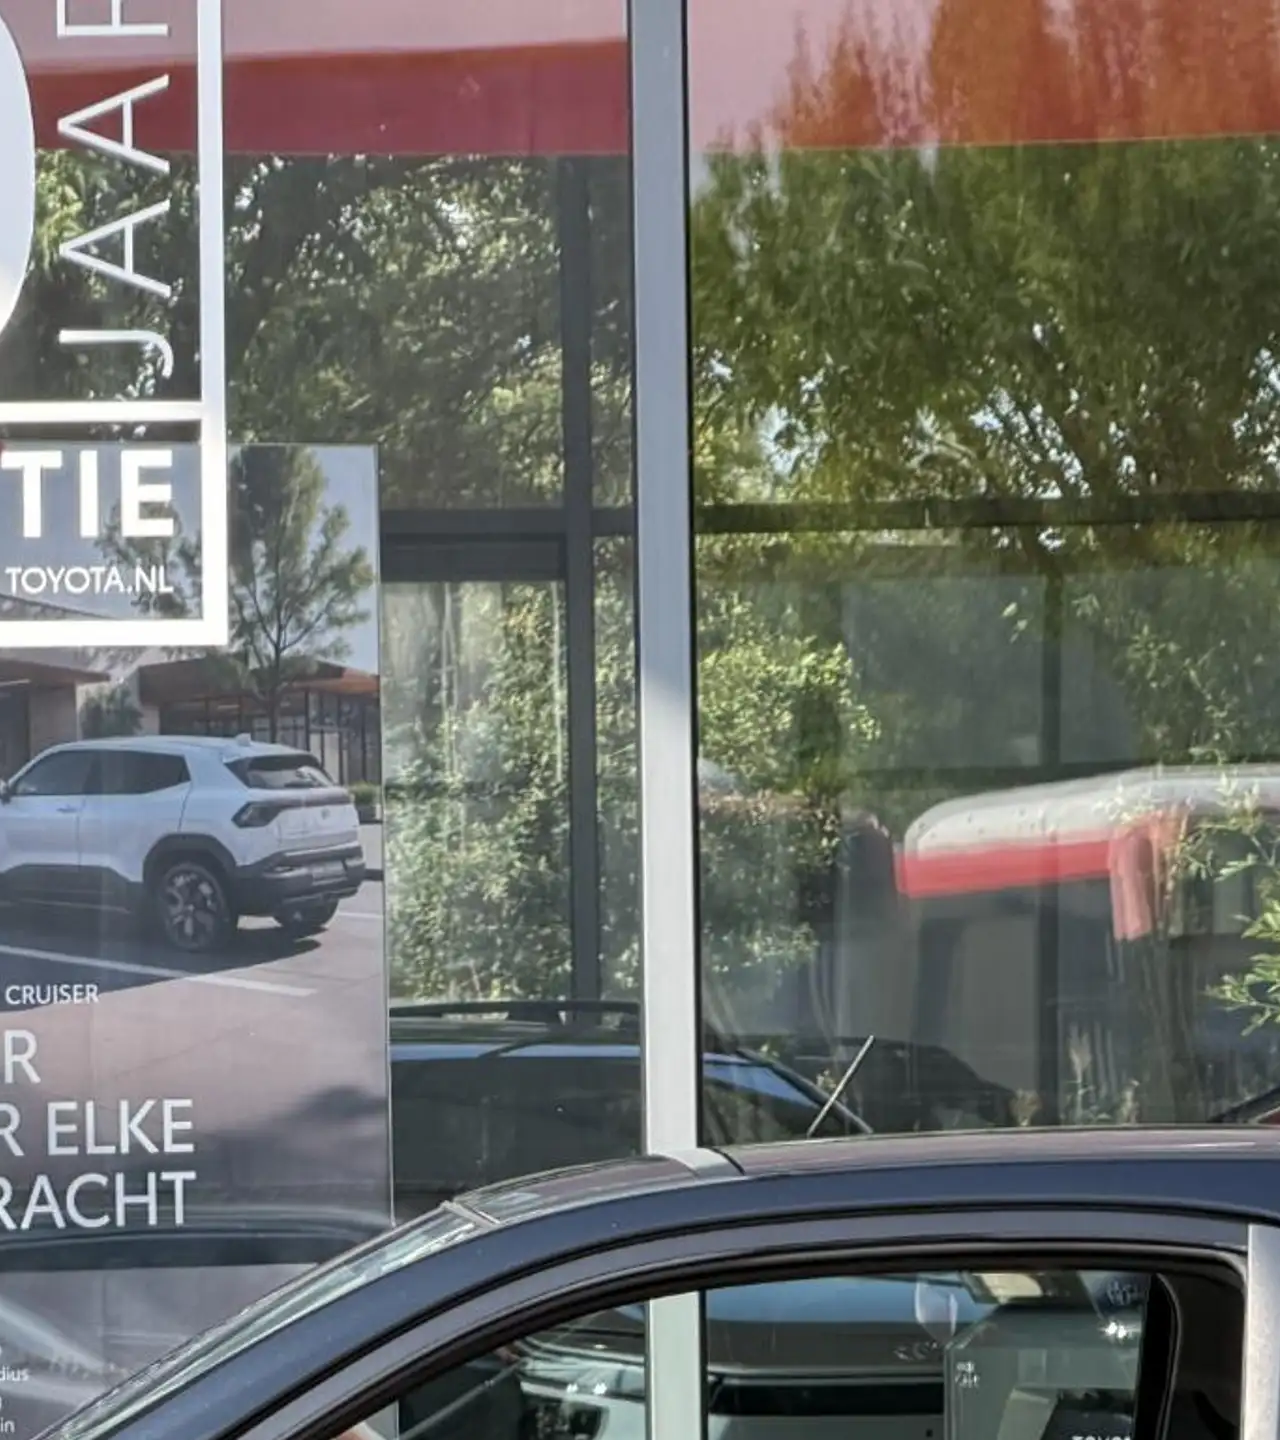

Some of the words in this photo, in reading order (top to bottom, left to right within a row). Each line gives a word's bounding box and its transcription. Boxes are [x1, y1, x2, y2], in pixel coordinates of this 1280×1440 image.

[5, 566, 175, 596] TOYOTA.NL
[5, 983, 99, 1005] CRUISER
[47, 1098, 195, 1156] ELKE
